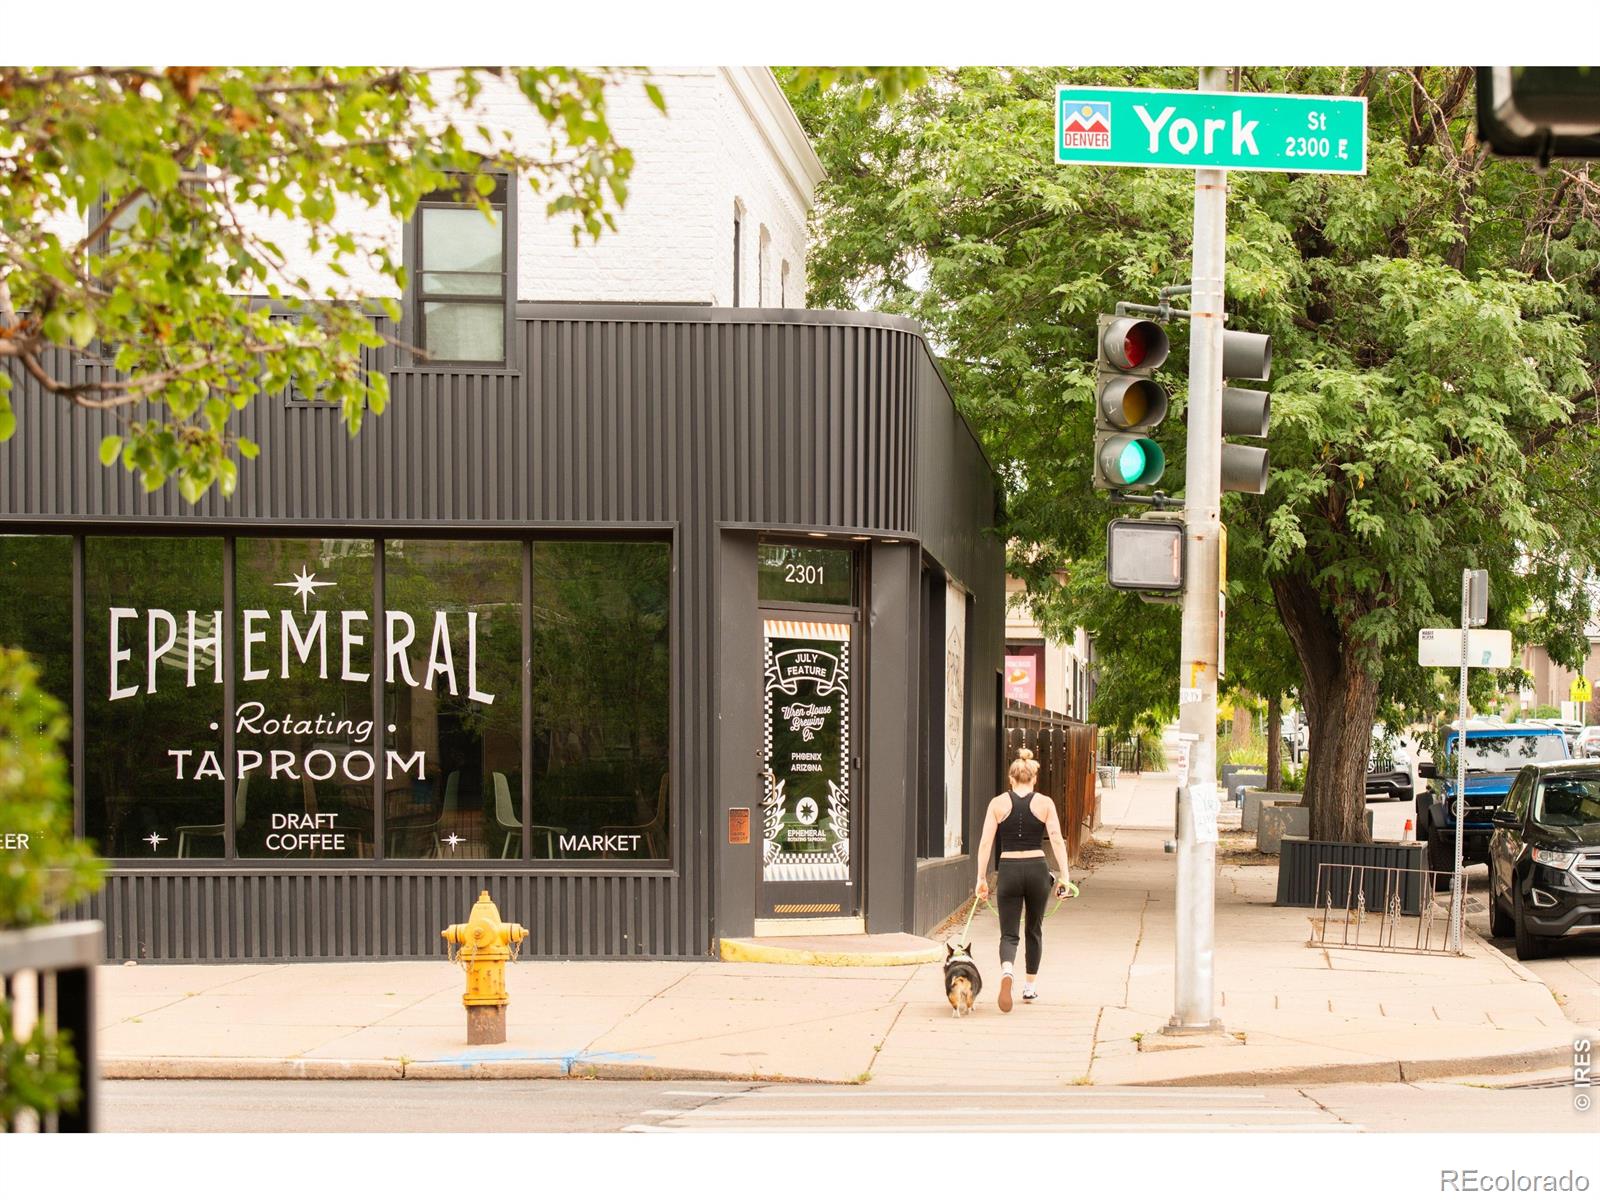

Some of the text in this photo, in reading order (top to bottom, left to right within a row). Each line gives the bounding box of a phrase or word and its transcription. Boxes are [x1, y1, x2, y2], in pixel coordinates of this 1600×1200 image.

[1307, 111, 1327, 131] St
[1132, 104, 1260, 156] York
[1064, 132, 1109, 147] DENVER
[1285, 136, 1349, 160] 2300 E
[785, 564, 824, 585] 2301
[108, 607, 496, 705] EPHEMERAL
[795, 653, 818, 663] JULY
[787, 665, 827, 677] FEATURE
[781, 703, 832, 719] Wren House
[236, 701, 374, 743] Rotating
[790, 716, 825, 731] Brewing
[168, 749, 426, 781] TAPROOM
[791, 752, 822, 761] PHOENIX
[791, 764, 823, 772] ARIZONA
[272, 813, 339, 830] DRAFT
[787, 829, 827, 837] EPHEMERAL
[265, 834, 346, 851] COFFEE
[559, 834, 641, 852] MARKET
